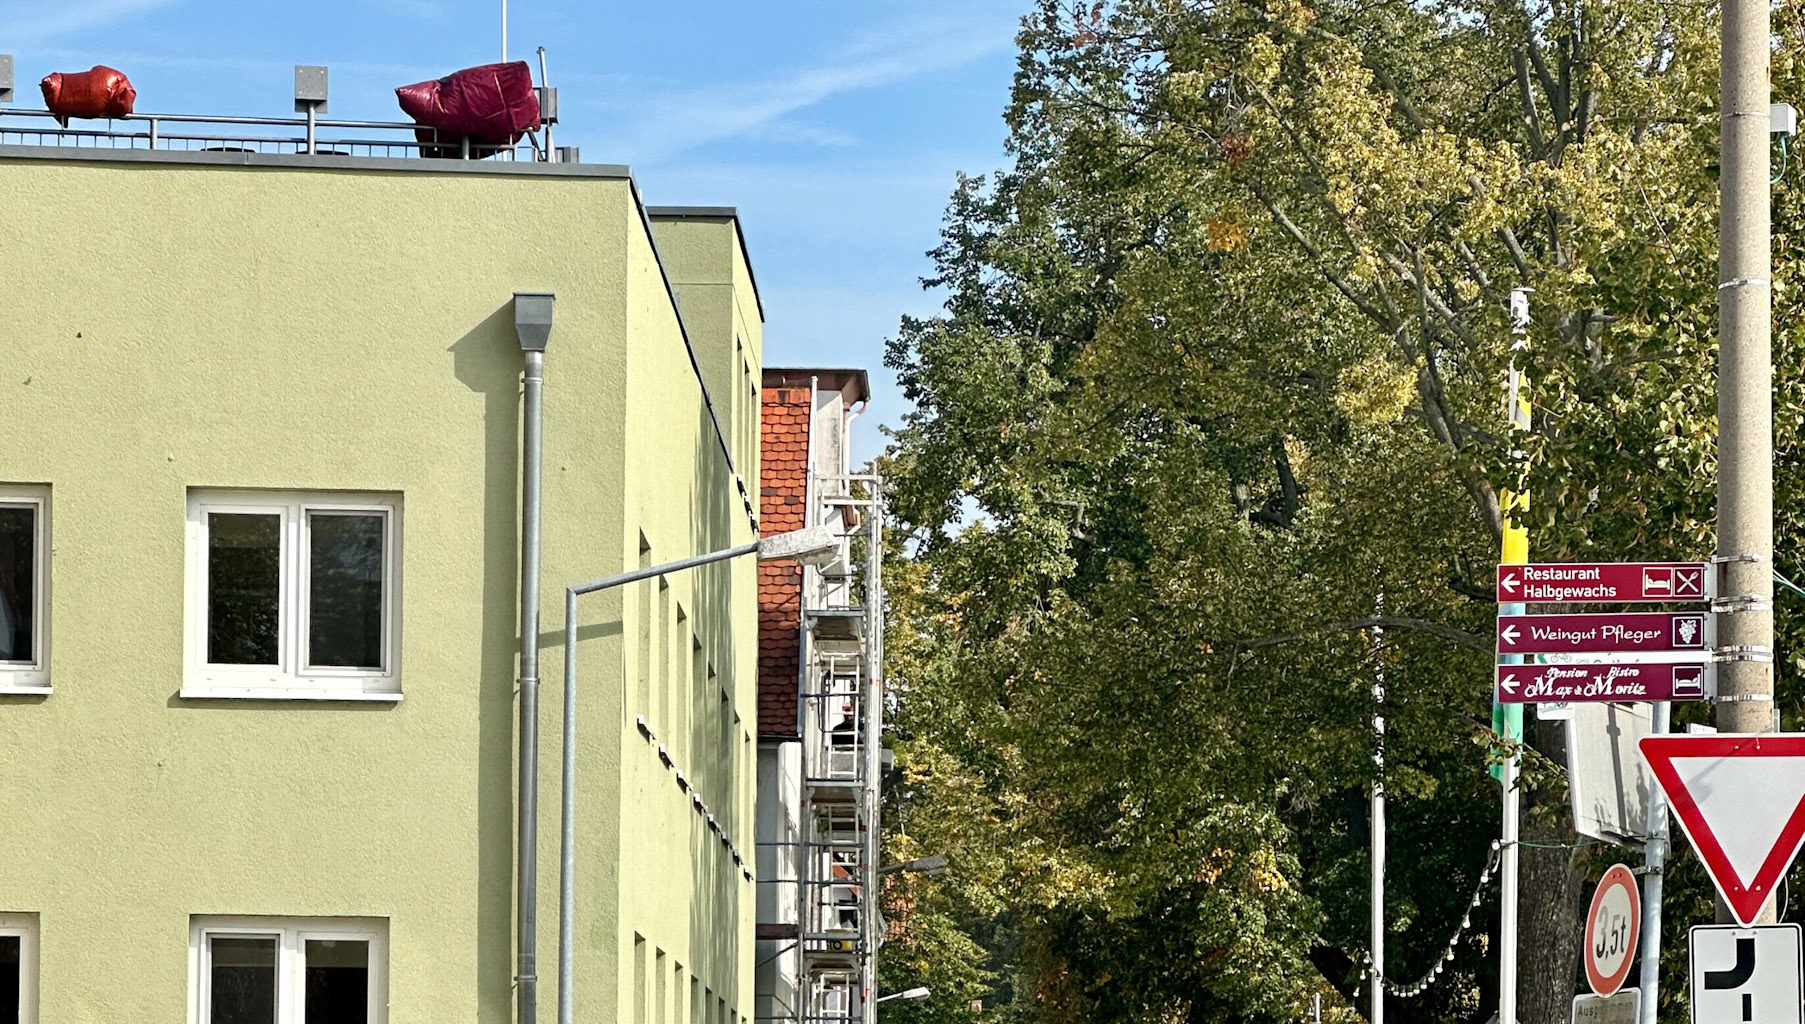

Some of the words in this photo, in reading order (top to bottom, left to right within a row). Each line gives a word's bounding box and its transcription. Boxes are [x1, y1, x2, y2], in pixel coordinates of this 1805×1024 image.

[1523, 567, 1600, 580] Restaurant
[1523, 585, 1617, 601] Halbgewachs
[1530, 626, 1597, 646] Weingut
[1601, 625, 1662, 644] Pfleger
[1544, 667, 1588, 678] Pension
[1606, 666, 1640, 678] Bistro
[1524, 676, 1573, 699] Max
[1583, 675, 1648, 696] Moritz
